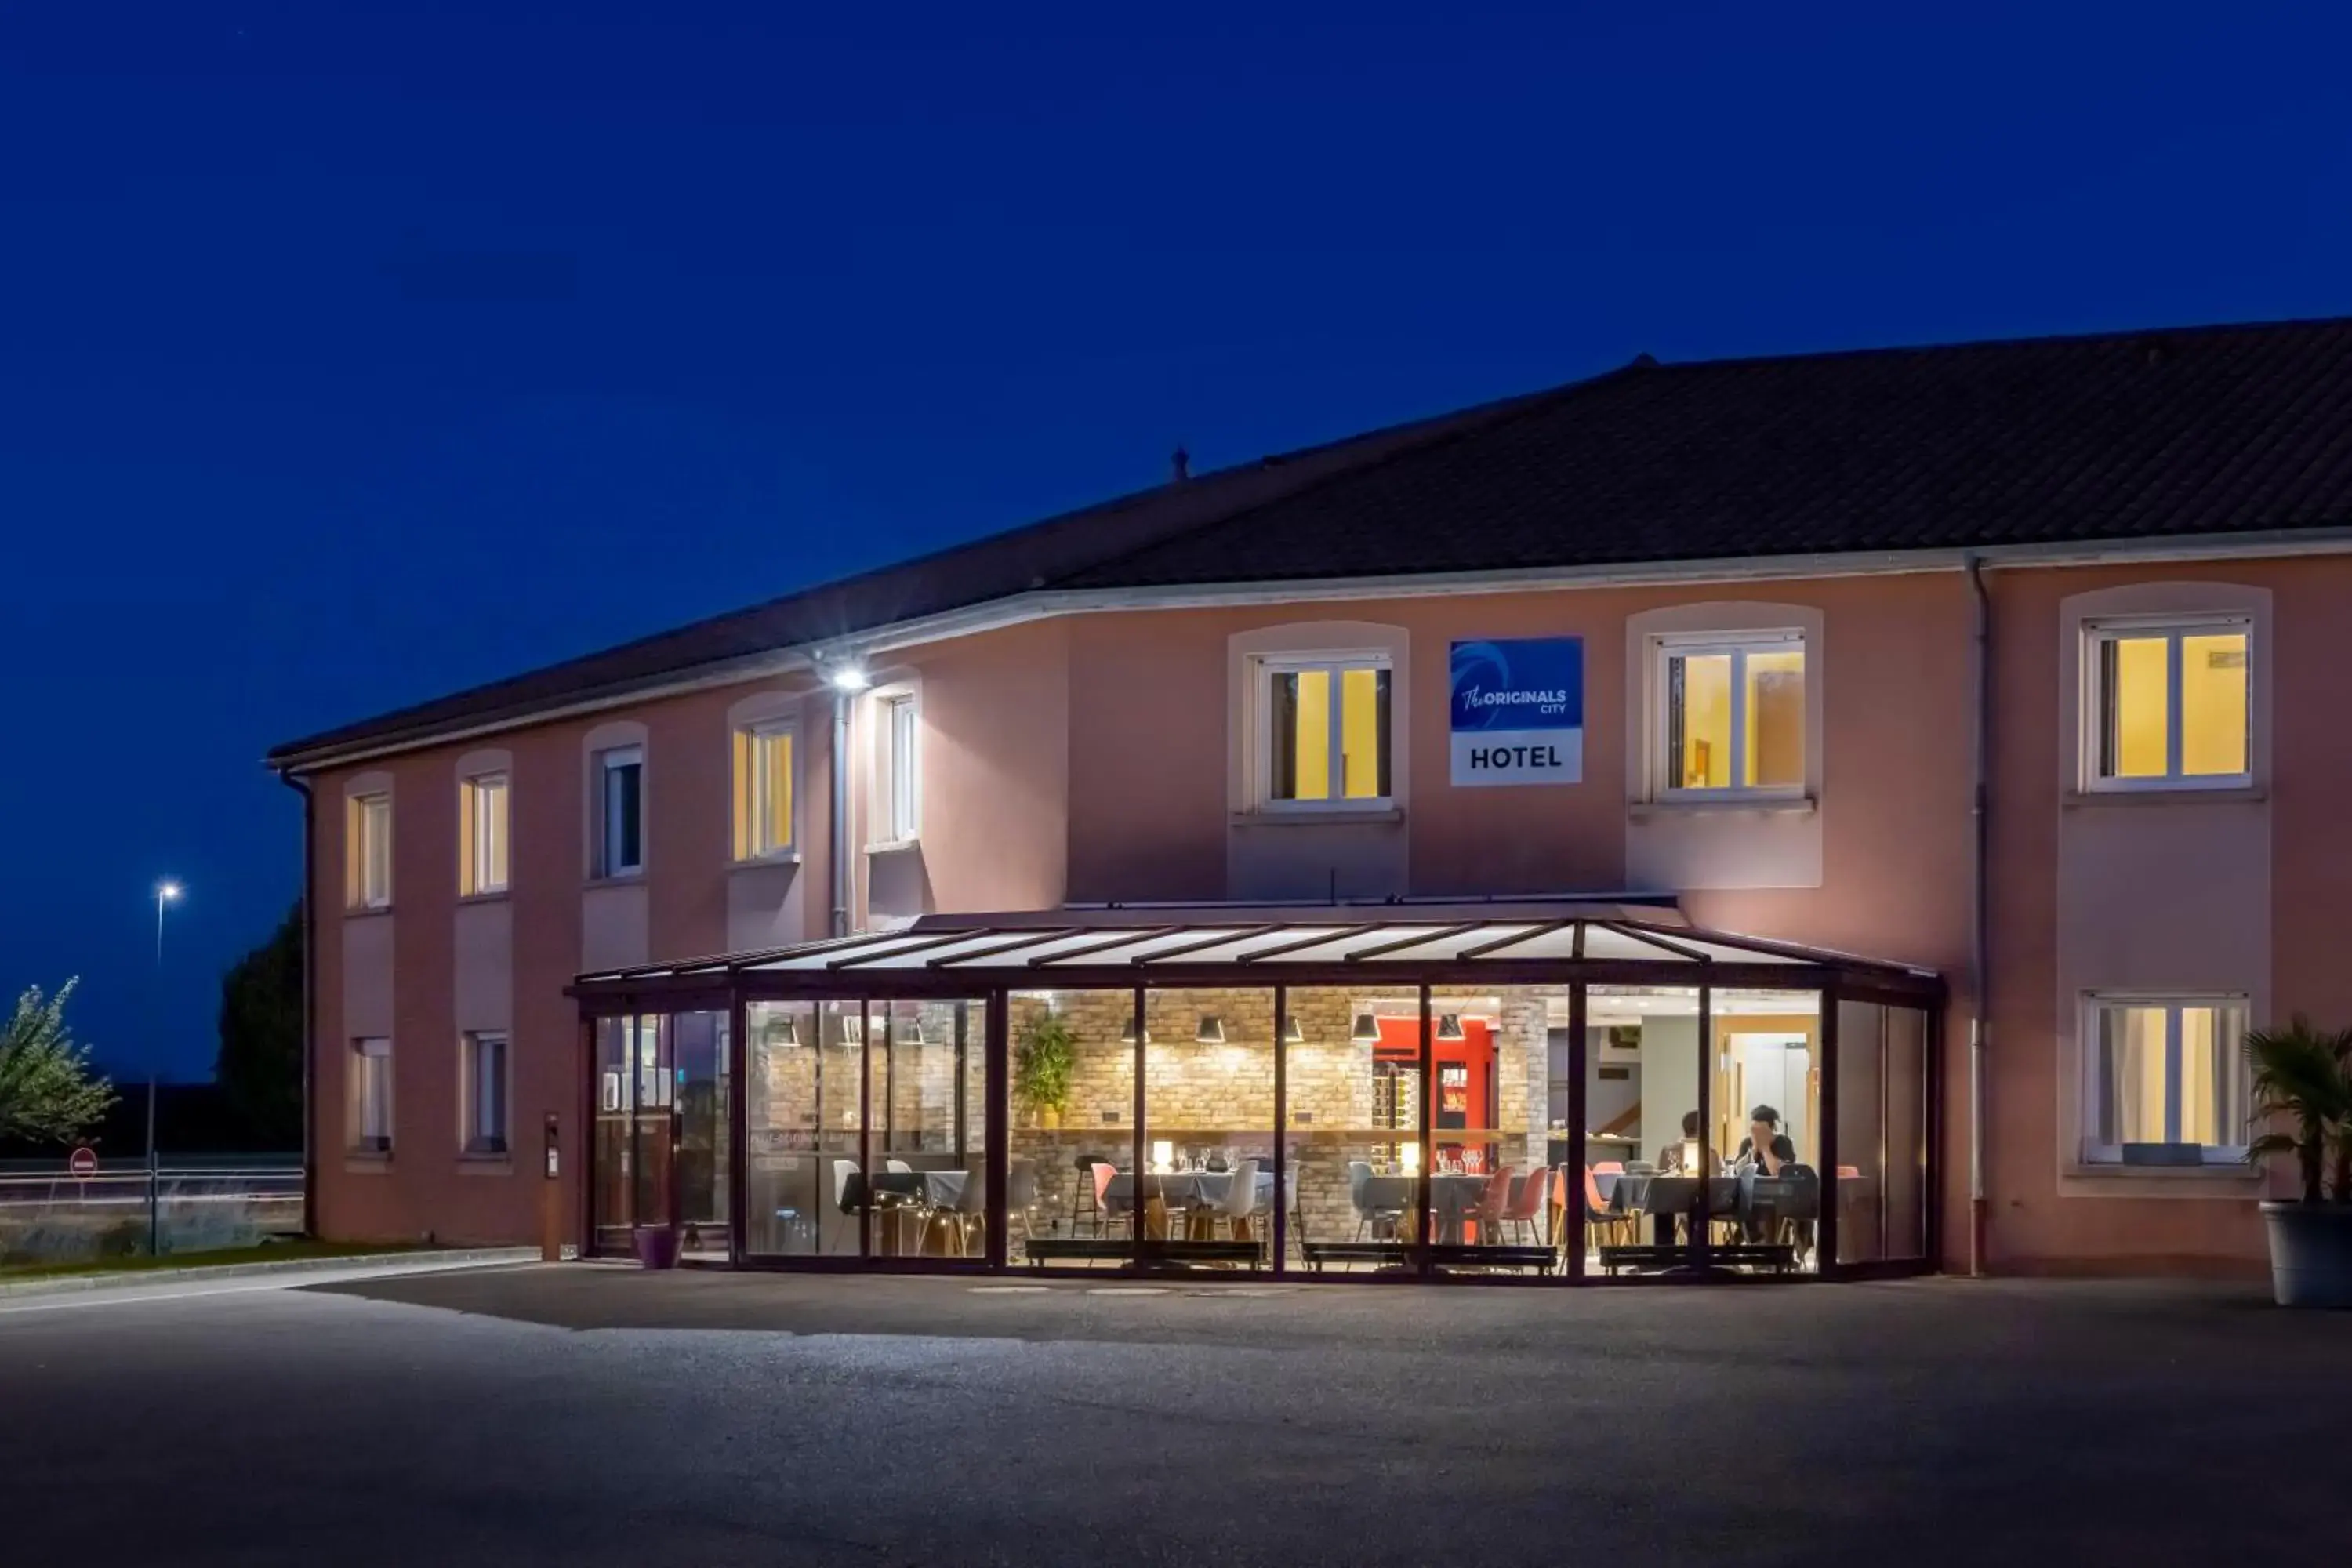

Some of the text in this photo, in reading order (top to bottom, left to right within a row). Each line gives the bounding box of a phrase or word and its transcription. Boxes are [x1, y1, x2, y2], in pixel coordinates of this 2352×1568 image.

[1462, 684, 1566, 711] The ORIGINALS
[1541, 704, 1566, 714] CITY
[1471, 746, 1562, 768] HOTEL
